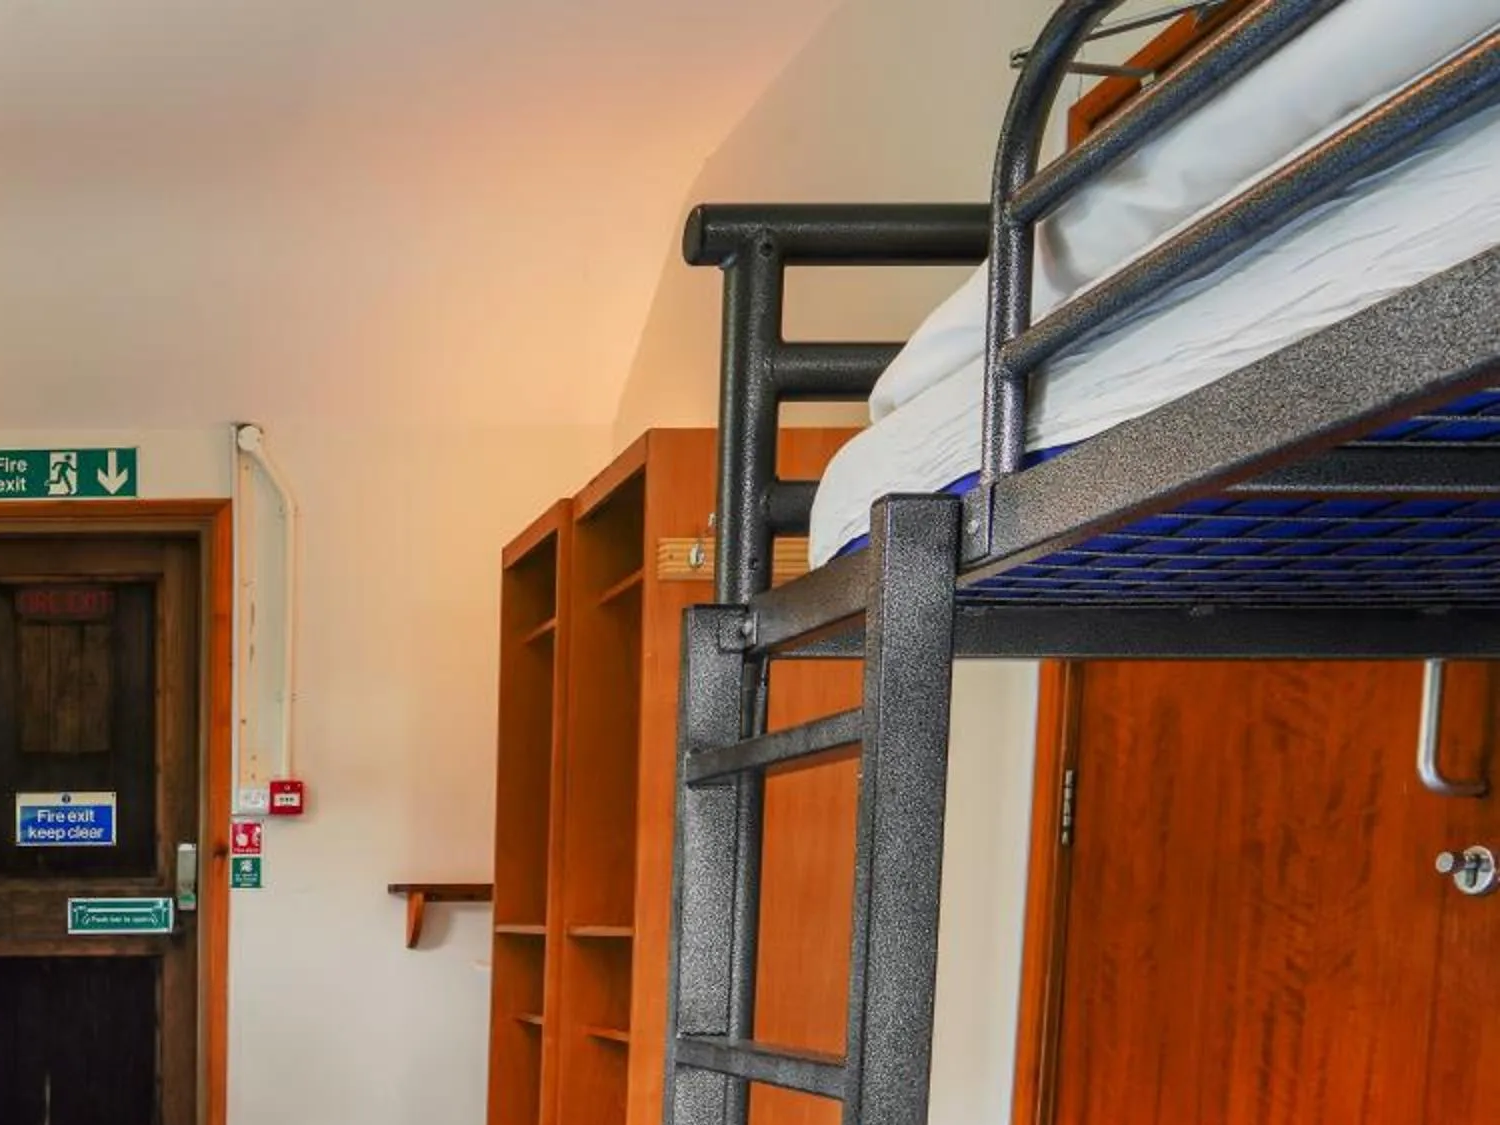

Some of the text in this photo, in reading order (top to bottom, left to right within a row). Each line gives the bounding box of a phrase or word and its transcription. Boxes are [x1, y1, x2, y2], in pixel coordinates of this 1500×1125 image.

[37, 808, 96, 823] Fire exit
[28, 825, 104, 841] keep clear
